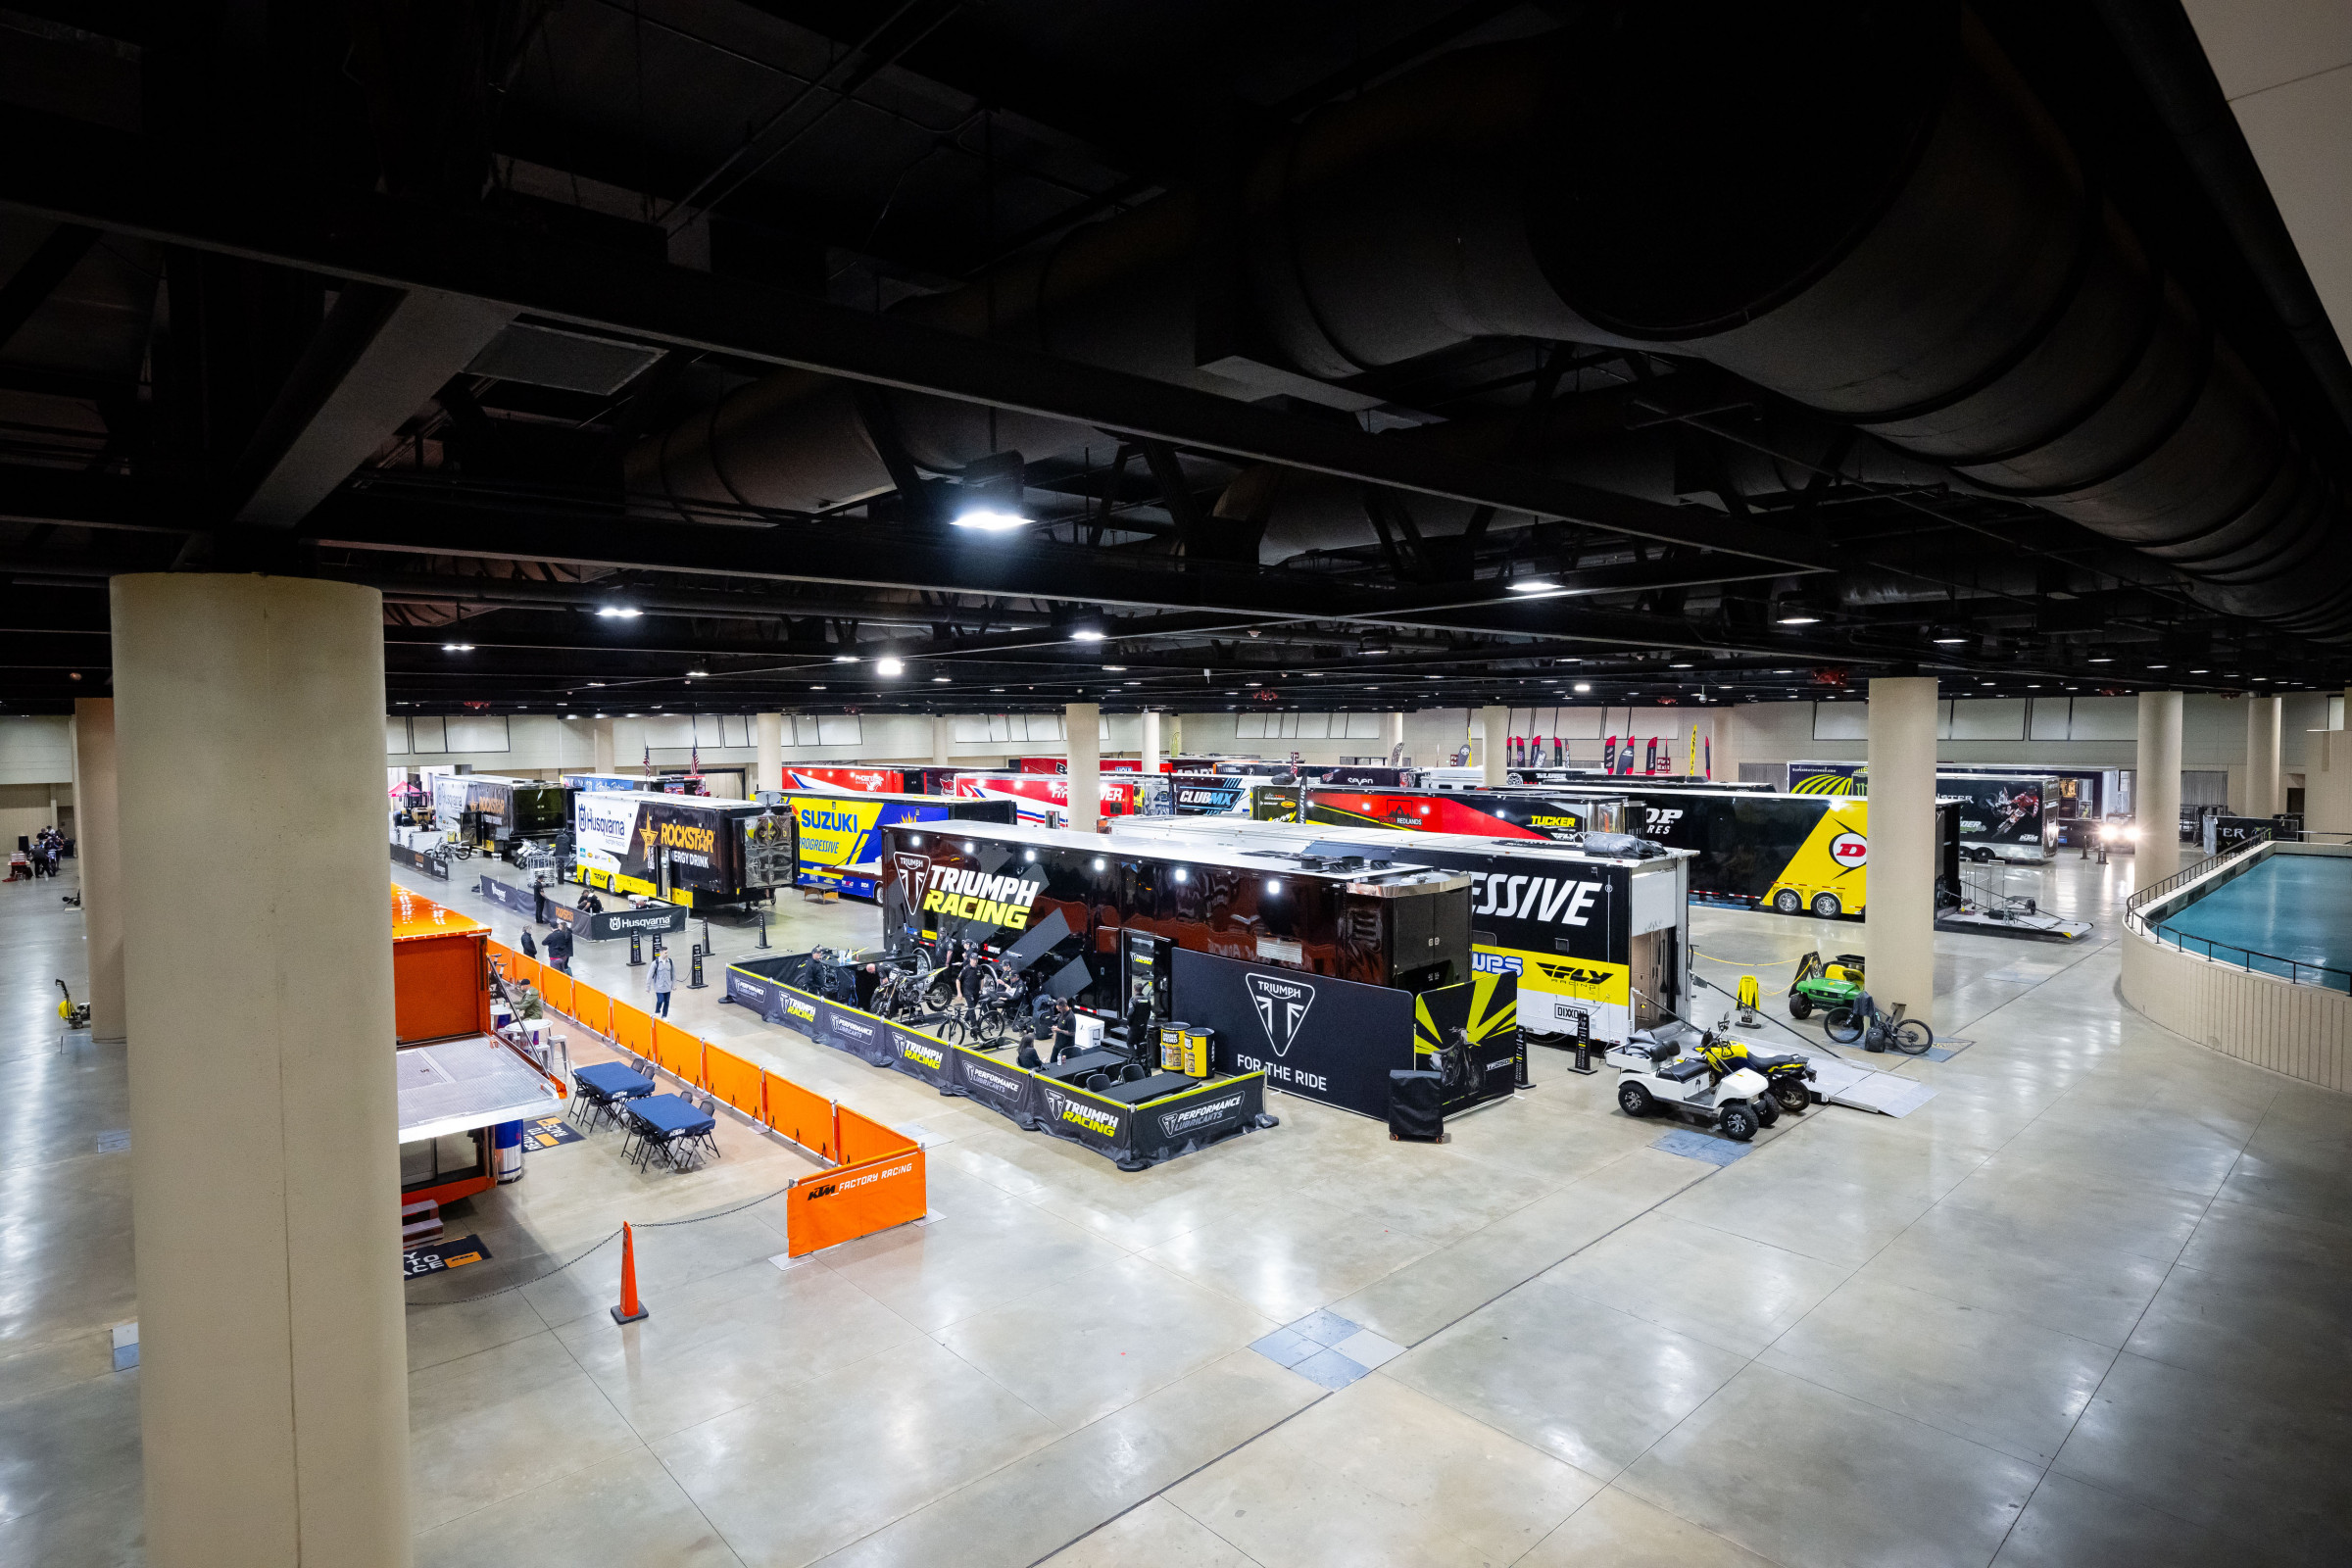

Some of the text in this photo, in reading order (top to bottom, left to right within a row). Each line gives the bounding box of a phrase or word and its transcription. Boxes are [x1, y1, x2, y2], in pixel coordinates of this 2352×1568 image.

[587, 811, 625, 836] Husqvarna
[801, 808, 858, 833] SUZUKI
[1531, 815, 1576, 828] TUCKER
[661, 823, 714, 854] ROCKSTAR
[689, 854, 710, 869] DRINK
[900, 857, 924, 868] TRIUMPH
[929, 864, 1041, 907] TRIUMPH
[922, 889, 1031, 930] RACING
[621, 915, 672, 930] Husqvarna
[1257, 980, 1301, 999] TRIUMPH
[787, 1005, 814, 1023] RACING
[788, 997, 816, 1015] TRIUMPH
[838, 1019, 873, 1036] PERFORMANCE
[904, 1049, 941, 1070] RACING
[905, 1039, 944, 1061] TRIUMPH
[974, 1069, 1019, 1092] PERFORMANCE
[1237, 1054, 1261, 1072] FOR
[1265, 1061, 1292, 1082] THE
[1295, 1069, 1328, 1092] RIDE
[612, 1090, 628, 1099] KTM
[973, 1076, 1005, 1093] LUBRICANTS
[1064, 1099, 1119, 1128] TRIUMPH
[1177, 1096, 1242, 1123] PERFORMANCE
[1062, 1111, 1116, 1138] RACING
[1175, 1110, 1224, 1132] LUBRICANTS
[668, 1128, 686, 1137] KTM
[808, 1184, 836, 1200] KTM
[407, 1254, 440, 1267] TO
